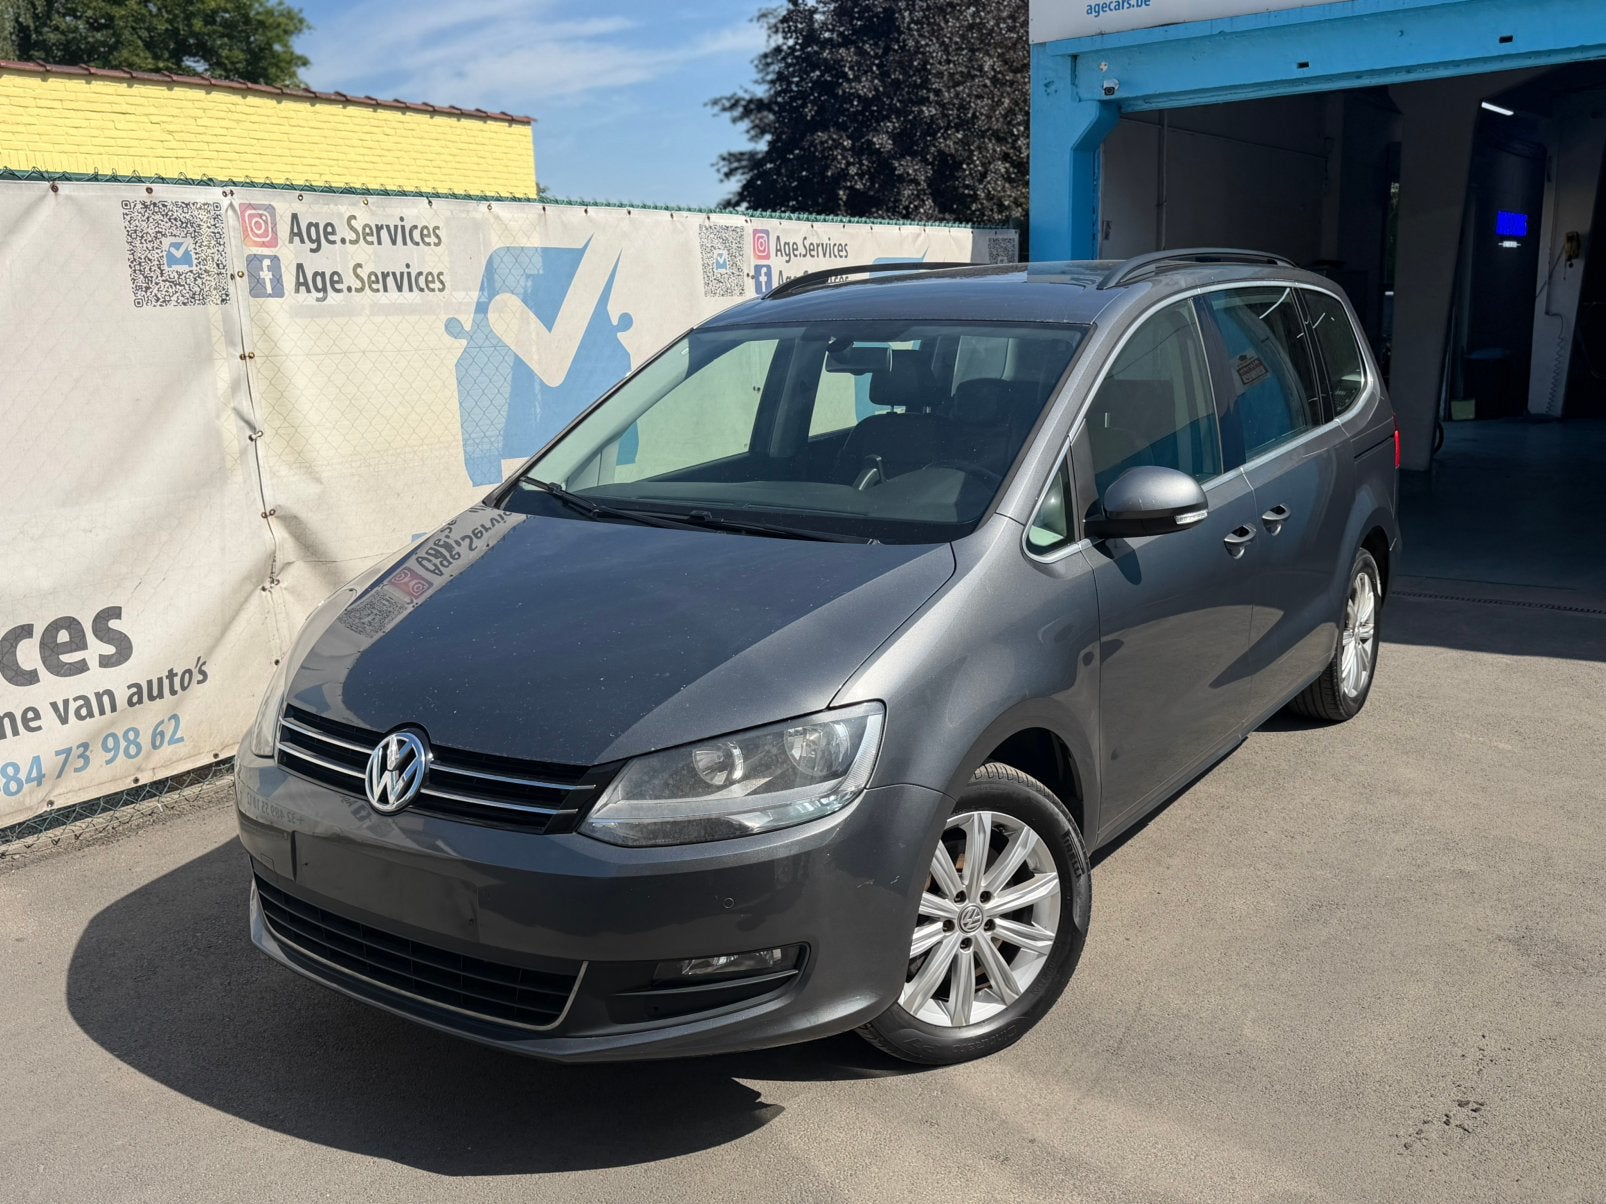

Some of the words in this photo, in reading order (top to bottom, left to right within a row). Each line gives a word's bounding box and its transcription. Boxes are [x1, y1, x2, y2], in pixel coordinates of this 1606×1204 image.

[1086, 0, 1151, 17] agecars.be
[288, 212, 442, 254] Age.Services
[775, 235, 849, 264] Age.Services
[294, 262, 446, 303] Age.Services
[0, 605, 134, 688] ces
[49, 687, 118, 726] van
[126, 655, 209, 709] auto's
[0, 754, 46, 798] 84
[54, 741, 91, 781] 73
[101, 726, 143, 766] 98
[150, 712, 185, 751] 62
[366, 732, 425, 812] VW
